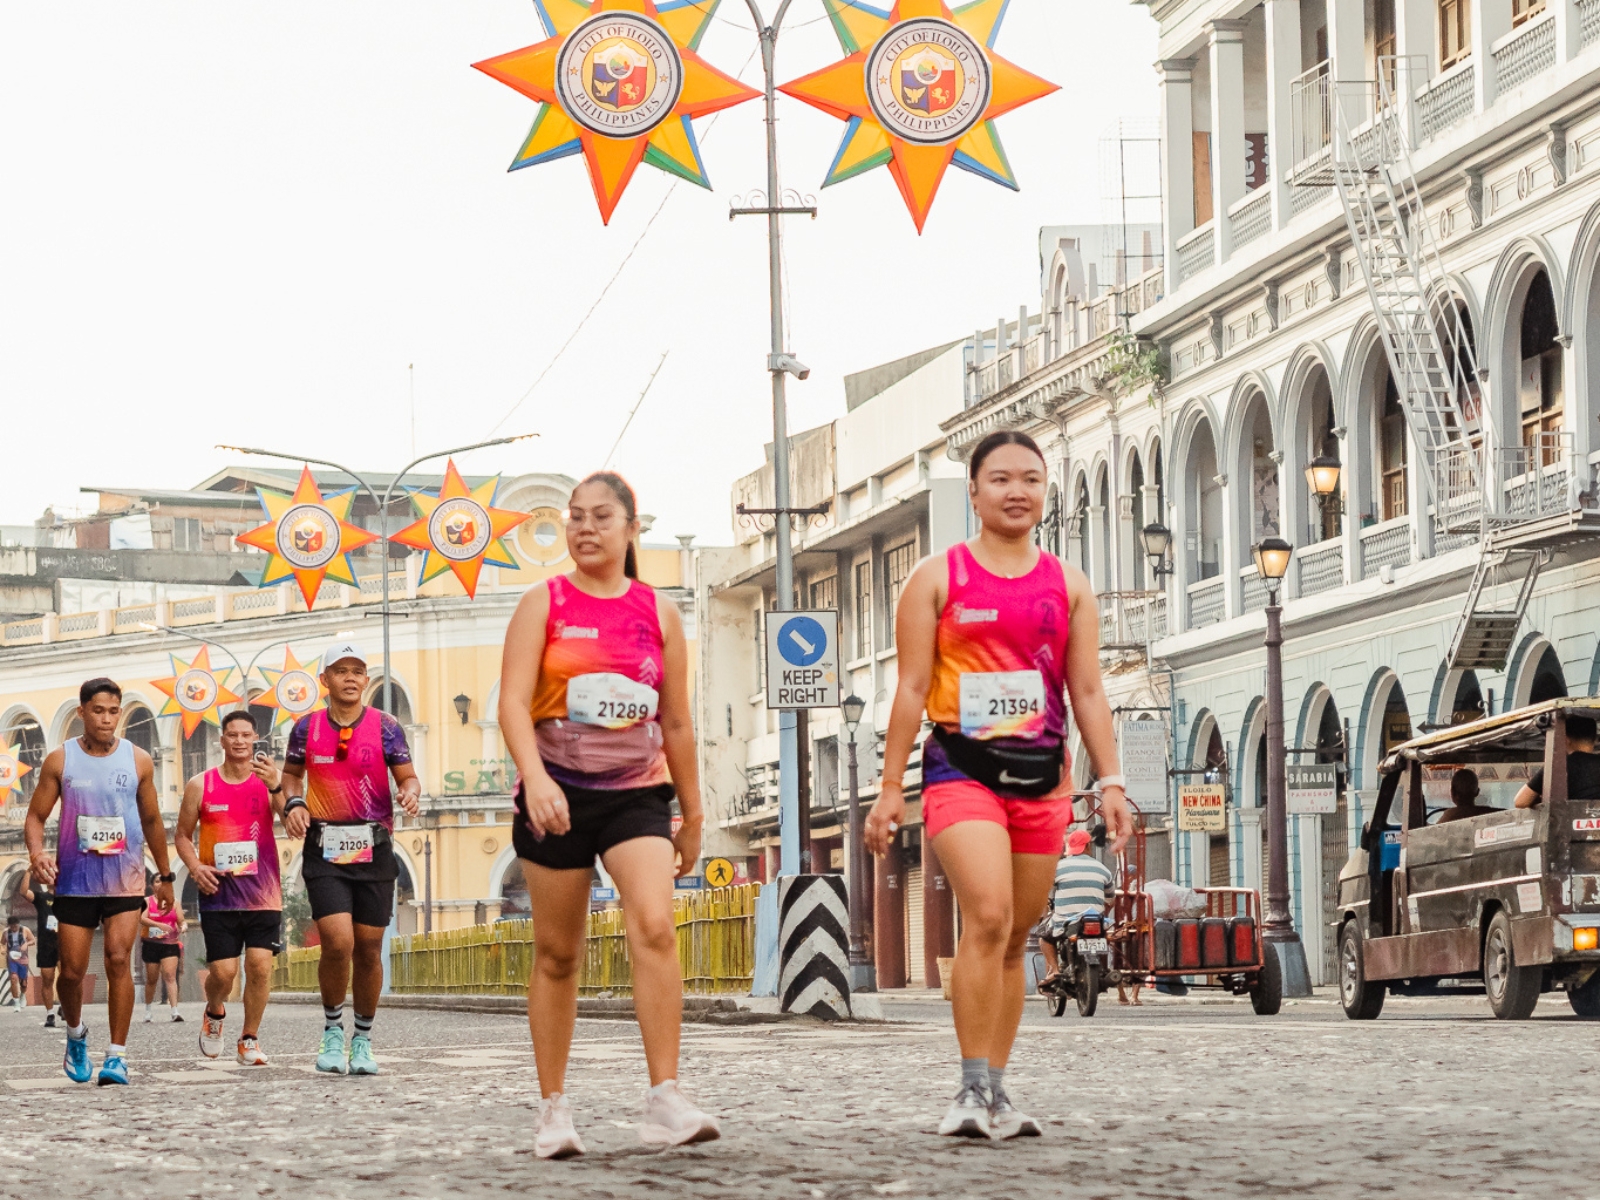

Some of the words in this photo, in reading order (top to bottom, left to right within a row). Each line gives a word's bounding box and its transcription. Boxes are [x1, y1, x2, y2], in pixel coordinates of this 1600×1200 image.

[579, 29, 604, 54] CITY
[607, 26, 625, 37] OF
[626, 27, 662, 60] ILOILO
[885, 35, 911, 62] CITY
[912, 31, 929, 42] OF
[932, 32, 969, 62] ILOILO
[575, 92, 660, 124] PHILIPPINES
[886, 100, 970, 130] PHILIPPINES
[783, 669, 823, 686] KEEP
[779, 687, 828, 704] RIGHT
[598, 700, 649, 720] 21289
[988, 698, 1039, 716] 21394
[1123, 722, 1148, 732] FATIMA
[115, 774, 128, 787] 42
[1288, 772, 1334, 783] SARABIA
[1183, 796, 1198, 807] NEW
[1200, 795, 1221, 807] CHINA
[92, 831, 123, 841] 42140
[339, 840, 369, 851] 21205
[228, 854, 254, 865] 21268
